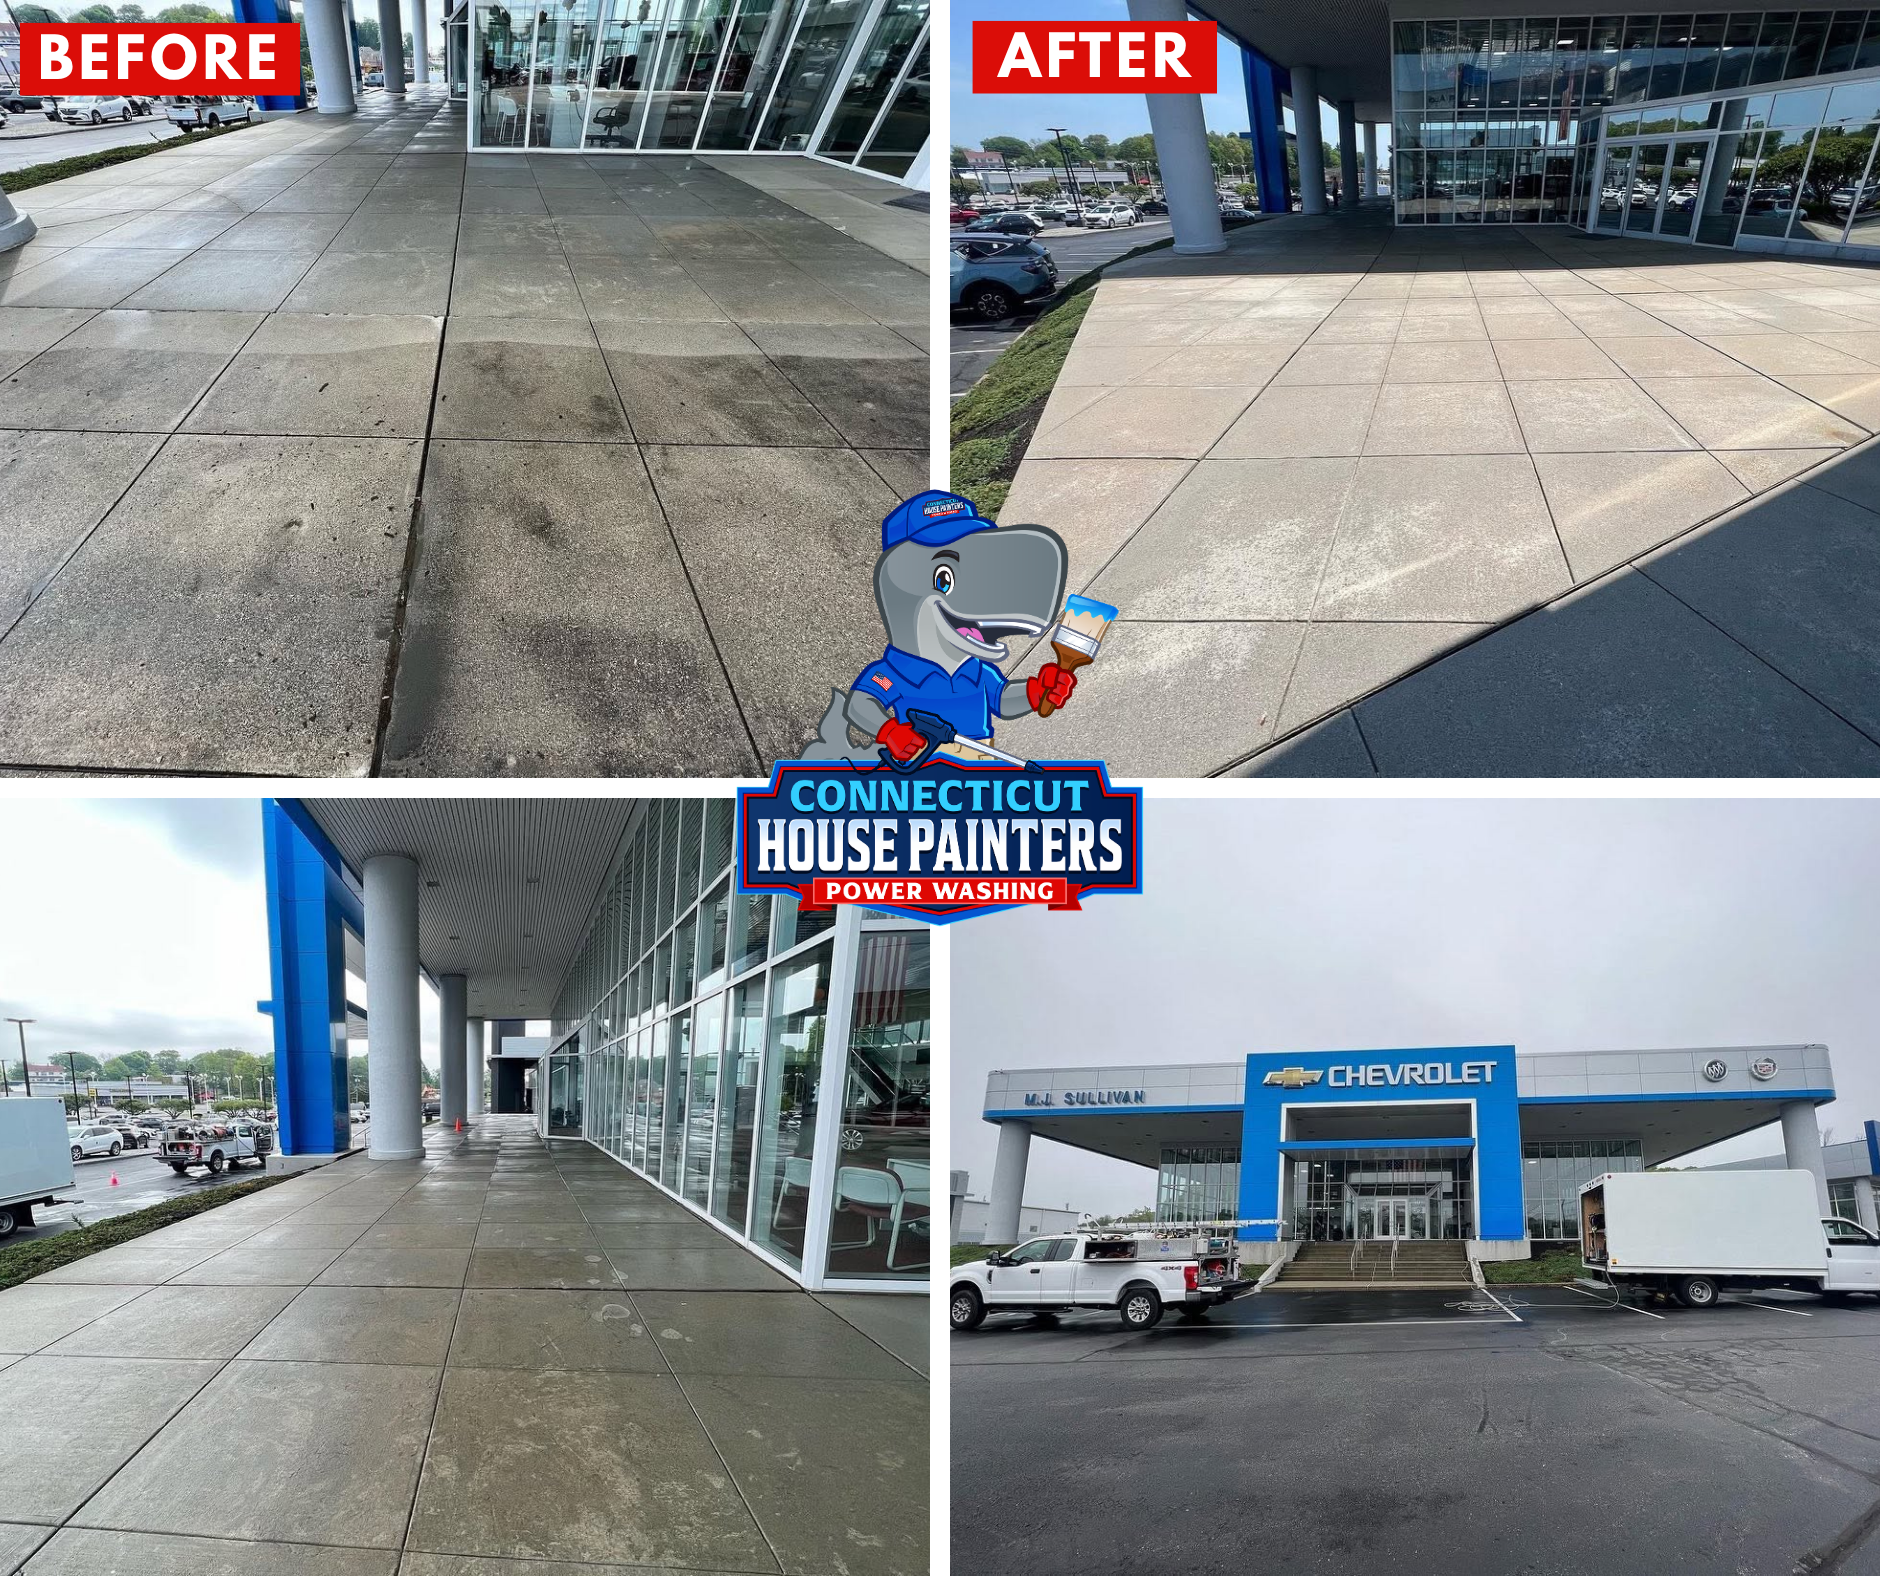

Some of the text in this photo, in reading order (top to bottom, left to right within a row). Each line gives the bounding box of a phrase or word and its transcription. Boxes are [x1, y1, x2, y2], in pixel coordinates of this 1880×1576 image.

[1328, 1061, 1497, 1087] CHEVROLET
[1024, 1090, 1145, 1106] M.J. SULLIVAN
